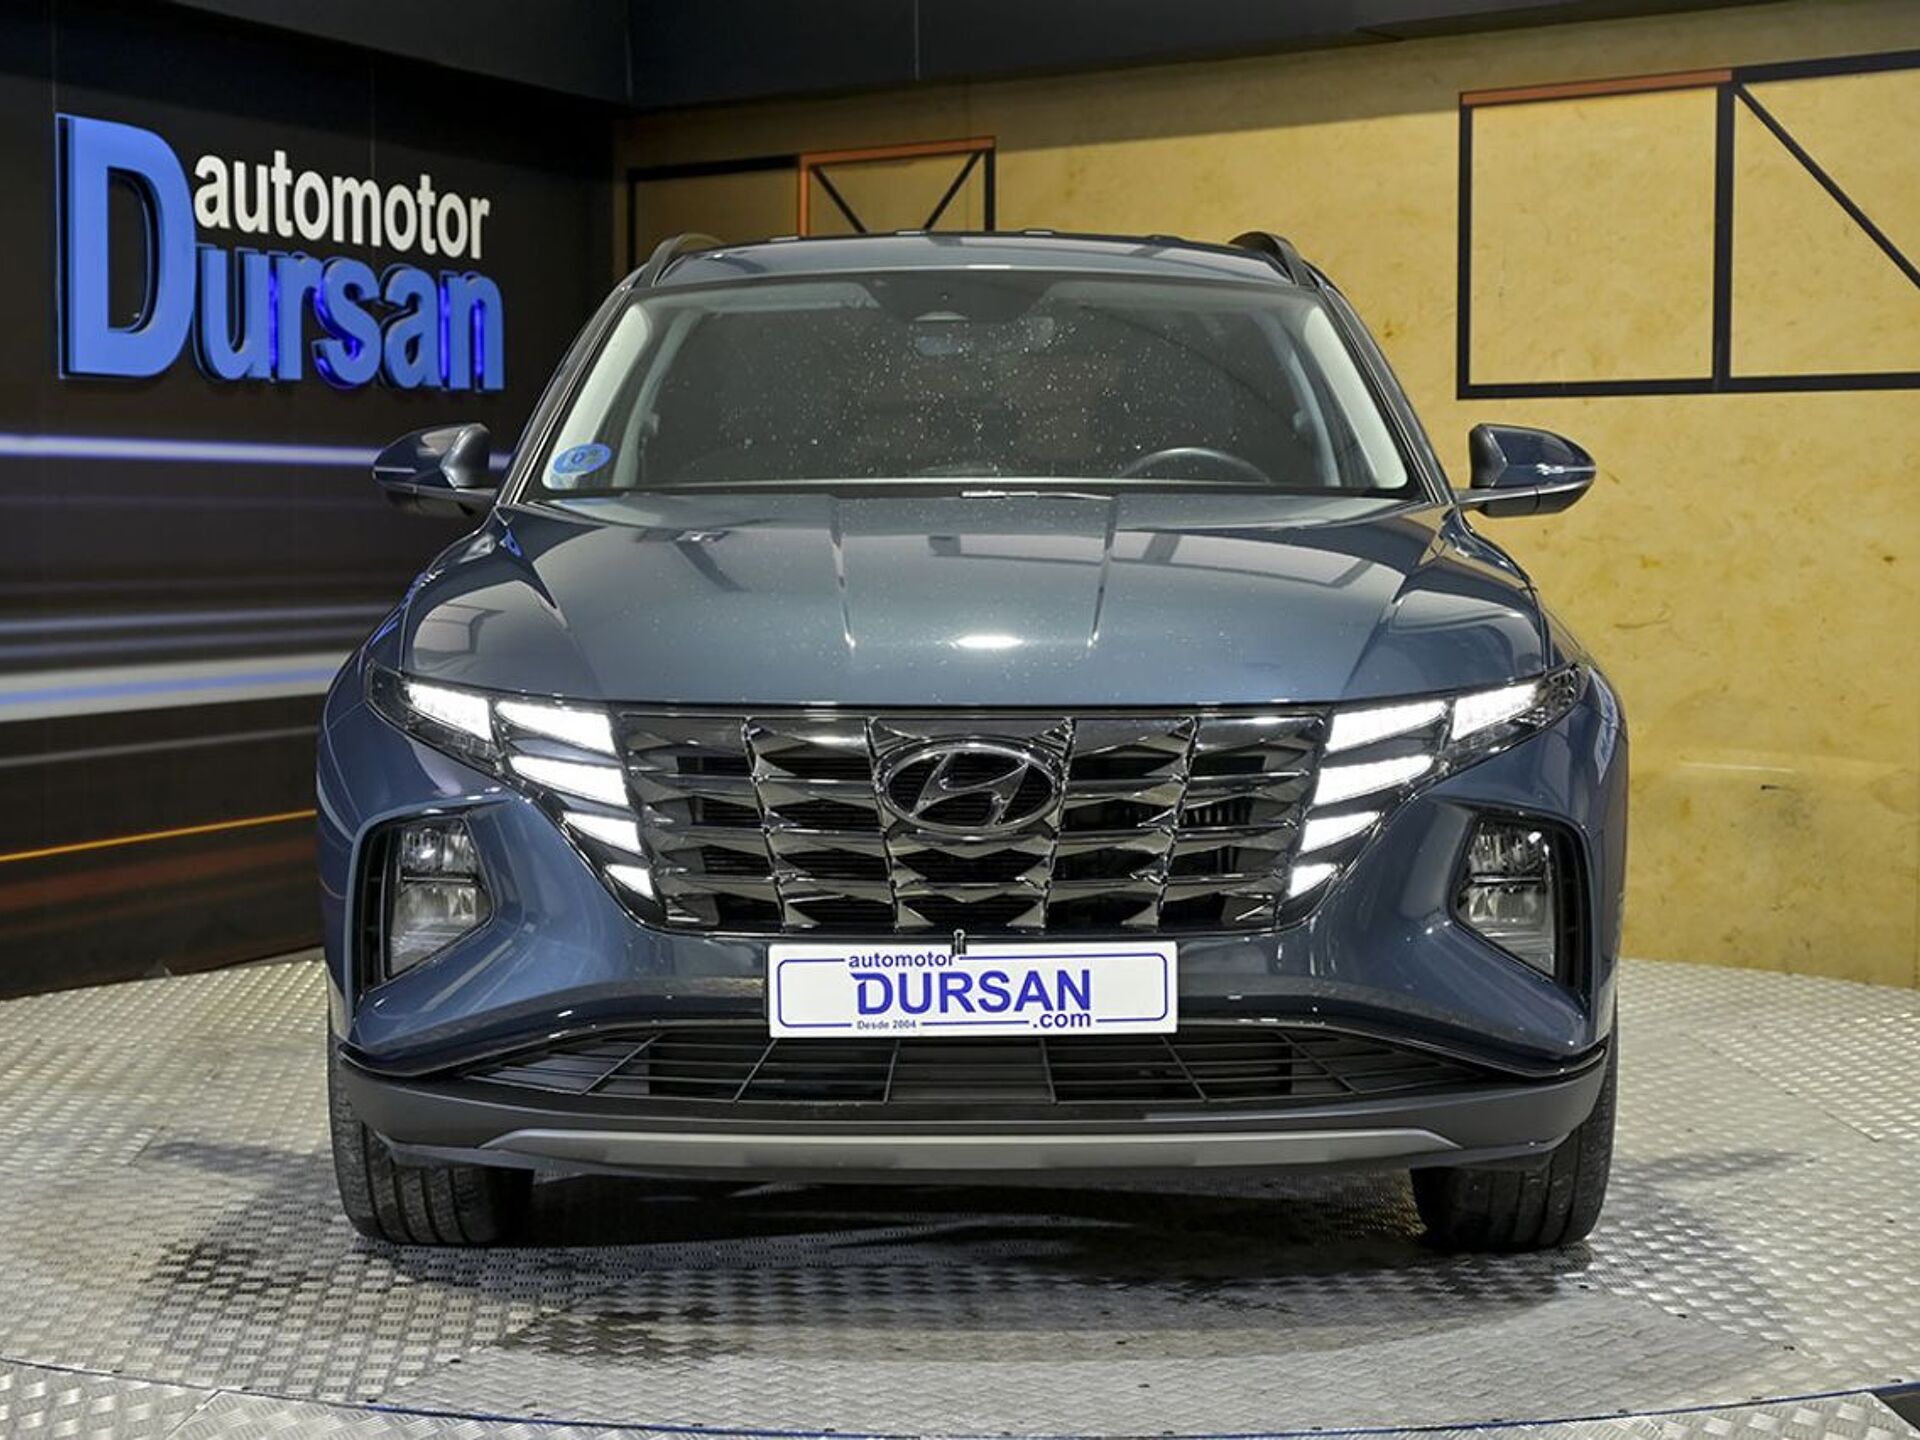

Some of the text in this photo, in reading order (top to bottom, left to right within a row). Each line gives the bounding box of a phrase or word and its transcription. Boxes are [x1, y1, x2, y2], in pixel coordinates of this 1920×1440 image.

[195, 150, 490, 259] automotor
[56, 112, 505, 391] Dursan
[849, 952, 955, 967] automotor
[850, 970, 1091, 1015] DURSAN
[857, 1019, 917, 1030] Desde 2004
[1033, 1013, 1091, 1029] .com
